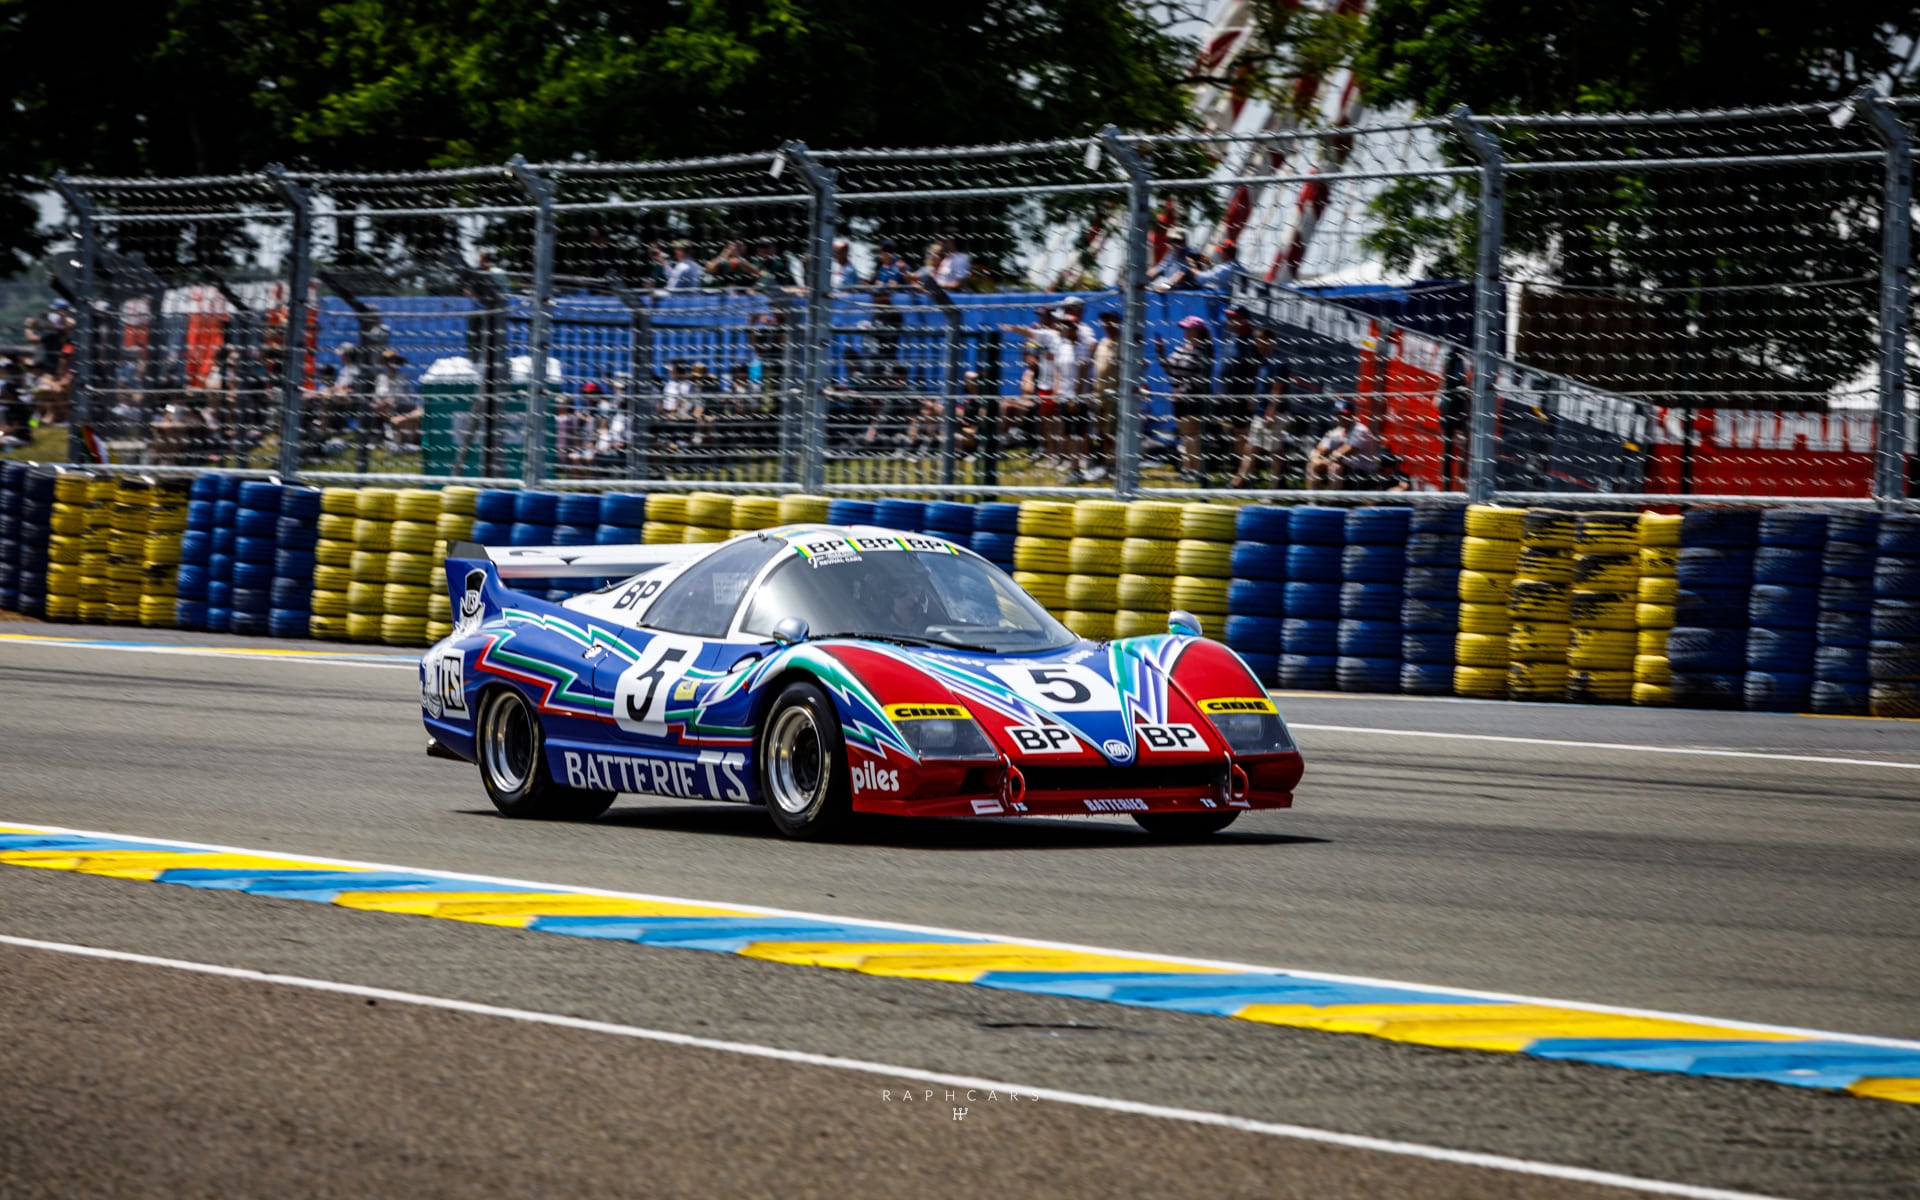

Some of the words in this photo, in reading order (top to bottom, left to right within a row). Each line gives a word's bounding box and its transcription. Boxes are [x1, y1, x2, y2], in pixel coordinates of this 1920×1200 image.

[807, 540, 845, 554] BP
[857, 538, 895, 550] BP
[907, 539, 942, 550] BP
[613, 580, 662, 610] BP
[443, 658, 464, 708] TS
[627, 648, 688, 722] 5
[1028, 668, 1091, 703] 5
[895, 707, 962, 717] CIBIE
[1207, 701, 1269, 710] CIBIE
[1012, 729, 1070, 750] BP
[1143, 727, 1197, 748] BP
[851, 760, 900, 795] piles
[1083, 798, 1149, 811] BATTERIES
